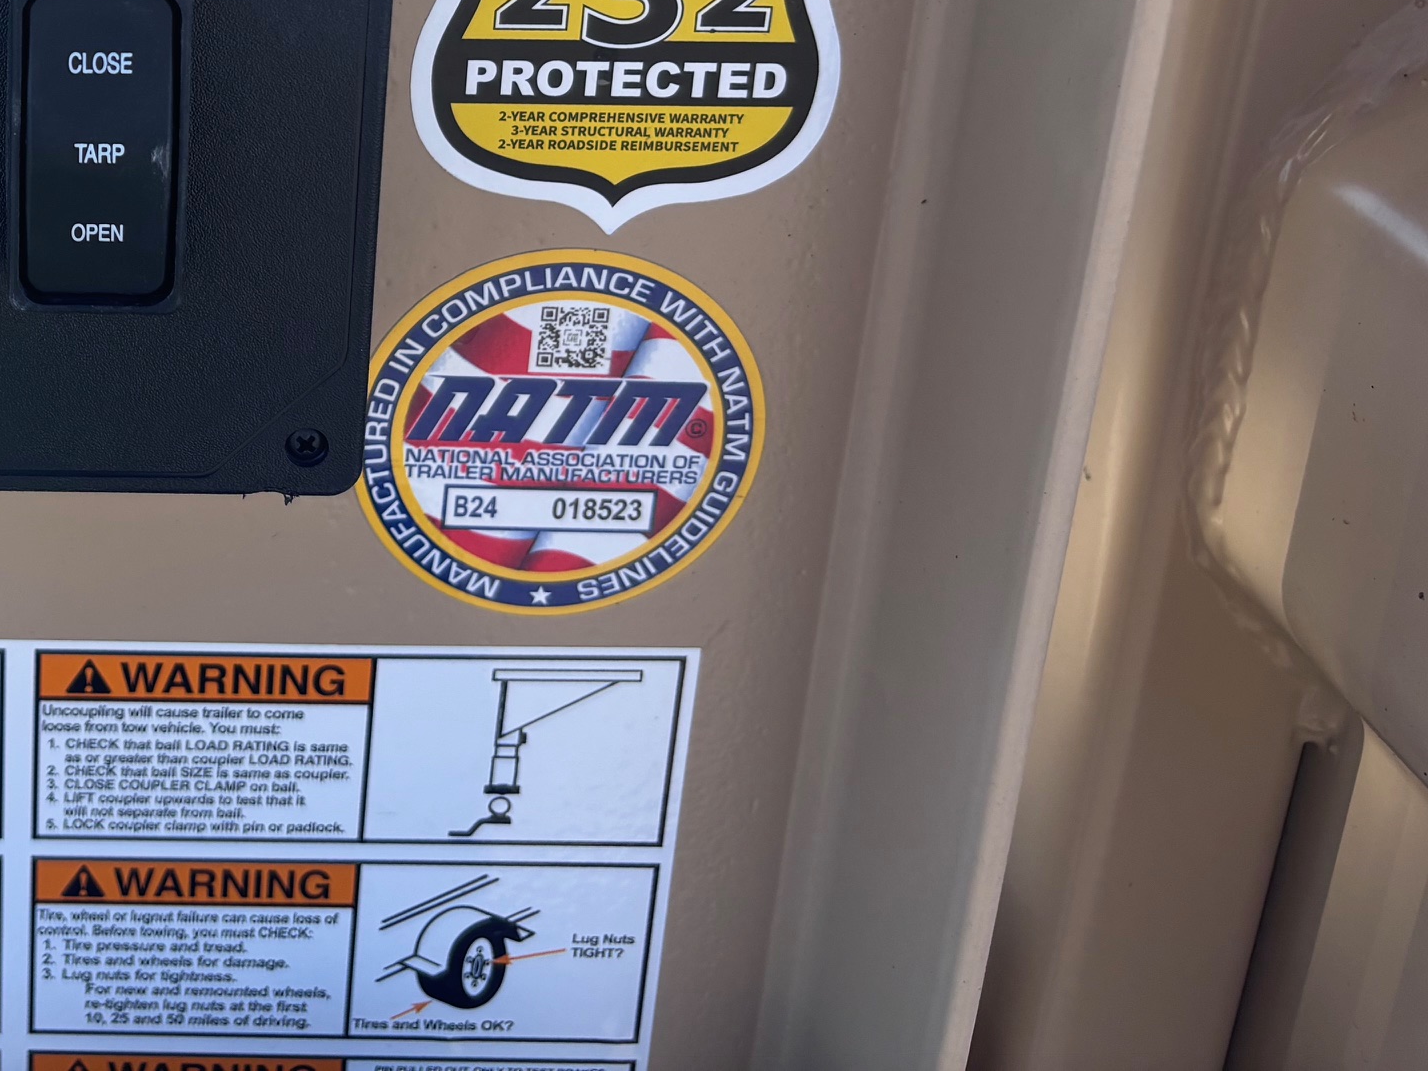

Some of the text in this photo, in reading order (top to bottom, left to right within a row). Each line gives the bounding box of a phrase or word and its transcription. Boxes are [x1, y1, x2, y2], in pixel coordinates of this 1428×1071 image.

[68, 52, 133, 75] CLOSE
[464, 59, 787, 99] PROTECTED
[498, 112, 745, 125] 2-YEAR COMPREHENSIVE WARRANTY
[511, 125, 730, 139] 3-YEAR STRUCTURAL WARRANTY
[73, 143, 125, 165] TARP
[497, 139, 739, 153] 2-YEAR ROADSIDE REIMBURSEMENT
[70, 222, 124, 243] OPEN
[405, 375, 710, 447] NATM
[364, 266, 752, 601] MANUFACTURED IN COMPLIANCE WITH NATM GUIDELINES
[405, 448, 701, 470] NATIONAL ASSOCIATION OF
[405, 463, 698, 485] TRAILER MANUFACTURERS
[453, 496, 643, 521] B24 018523
[120, 662, 346, 697] WARNING
[42, 704, 304, 719] Uncoupling will cause trailer to come
[42, 721, 281, 735] loose from tow vehicle. You must:
[48, 739, 348, 752] 1. CHECK that ball LOAD RATING is same
[47, 779, 300, 792] 3. CLOSE COUPLER CLAMP on ball.
[116, 868, 331, 900] WARNING
[572, 933, 635, 946] Lug Nuts
[572, 948, 624, 958] TIGHT?
[353, 1018, 514, 1031] Tires and Wheels OK?
